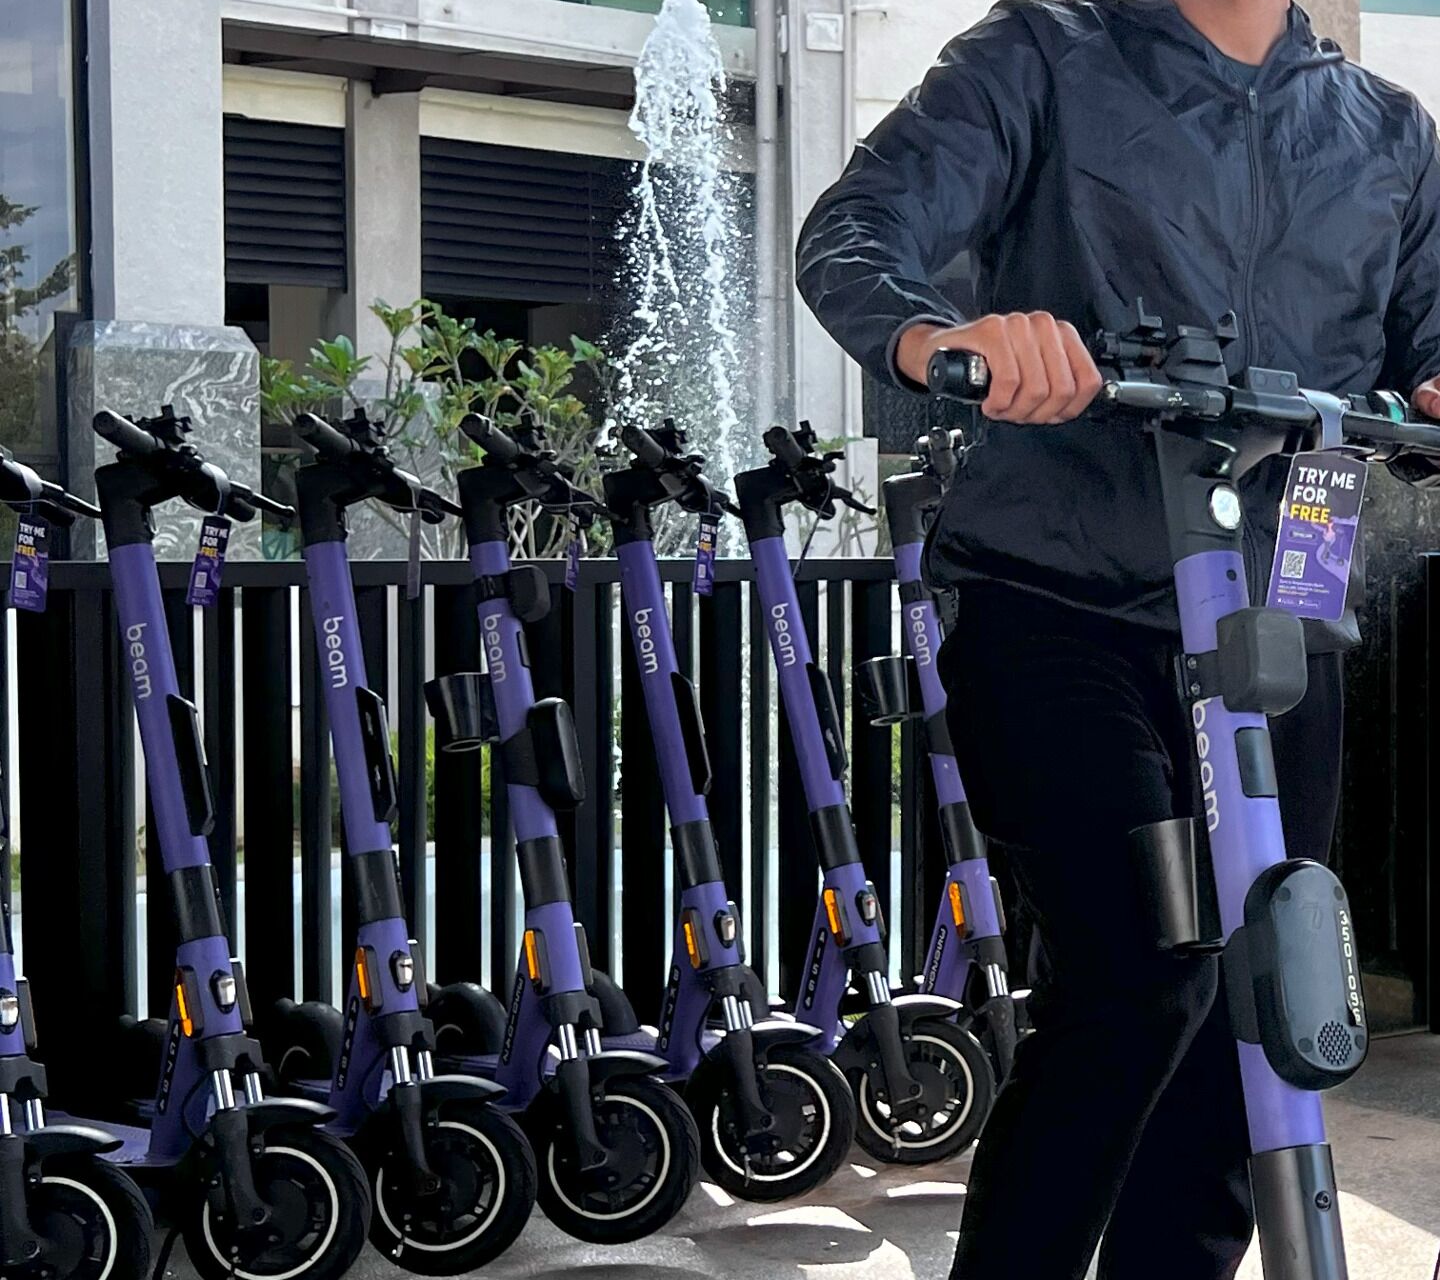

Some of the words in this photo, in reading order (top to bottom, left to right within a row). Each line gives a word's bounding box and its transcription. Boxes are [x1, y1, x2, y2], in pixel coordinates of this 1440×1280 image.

[1292, 485, 1328, 505] FOR
[1298, 467, 1329, 486] TRY
[1330, 471, 1357, 490] ME
[1289, 504, 1331, 524] FREE
[126, 622, 152, 699] beam
[323, 615, 348, 689] beam
[484, 613, 507, 683] beam
[634, 607, 659, 675] beam
[771, 602, 796, 667] beam
[909, 605, 932, 666] beam
[1191, 698, 1220, 833] beam
